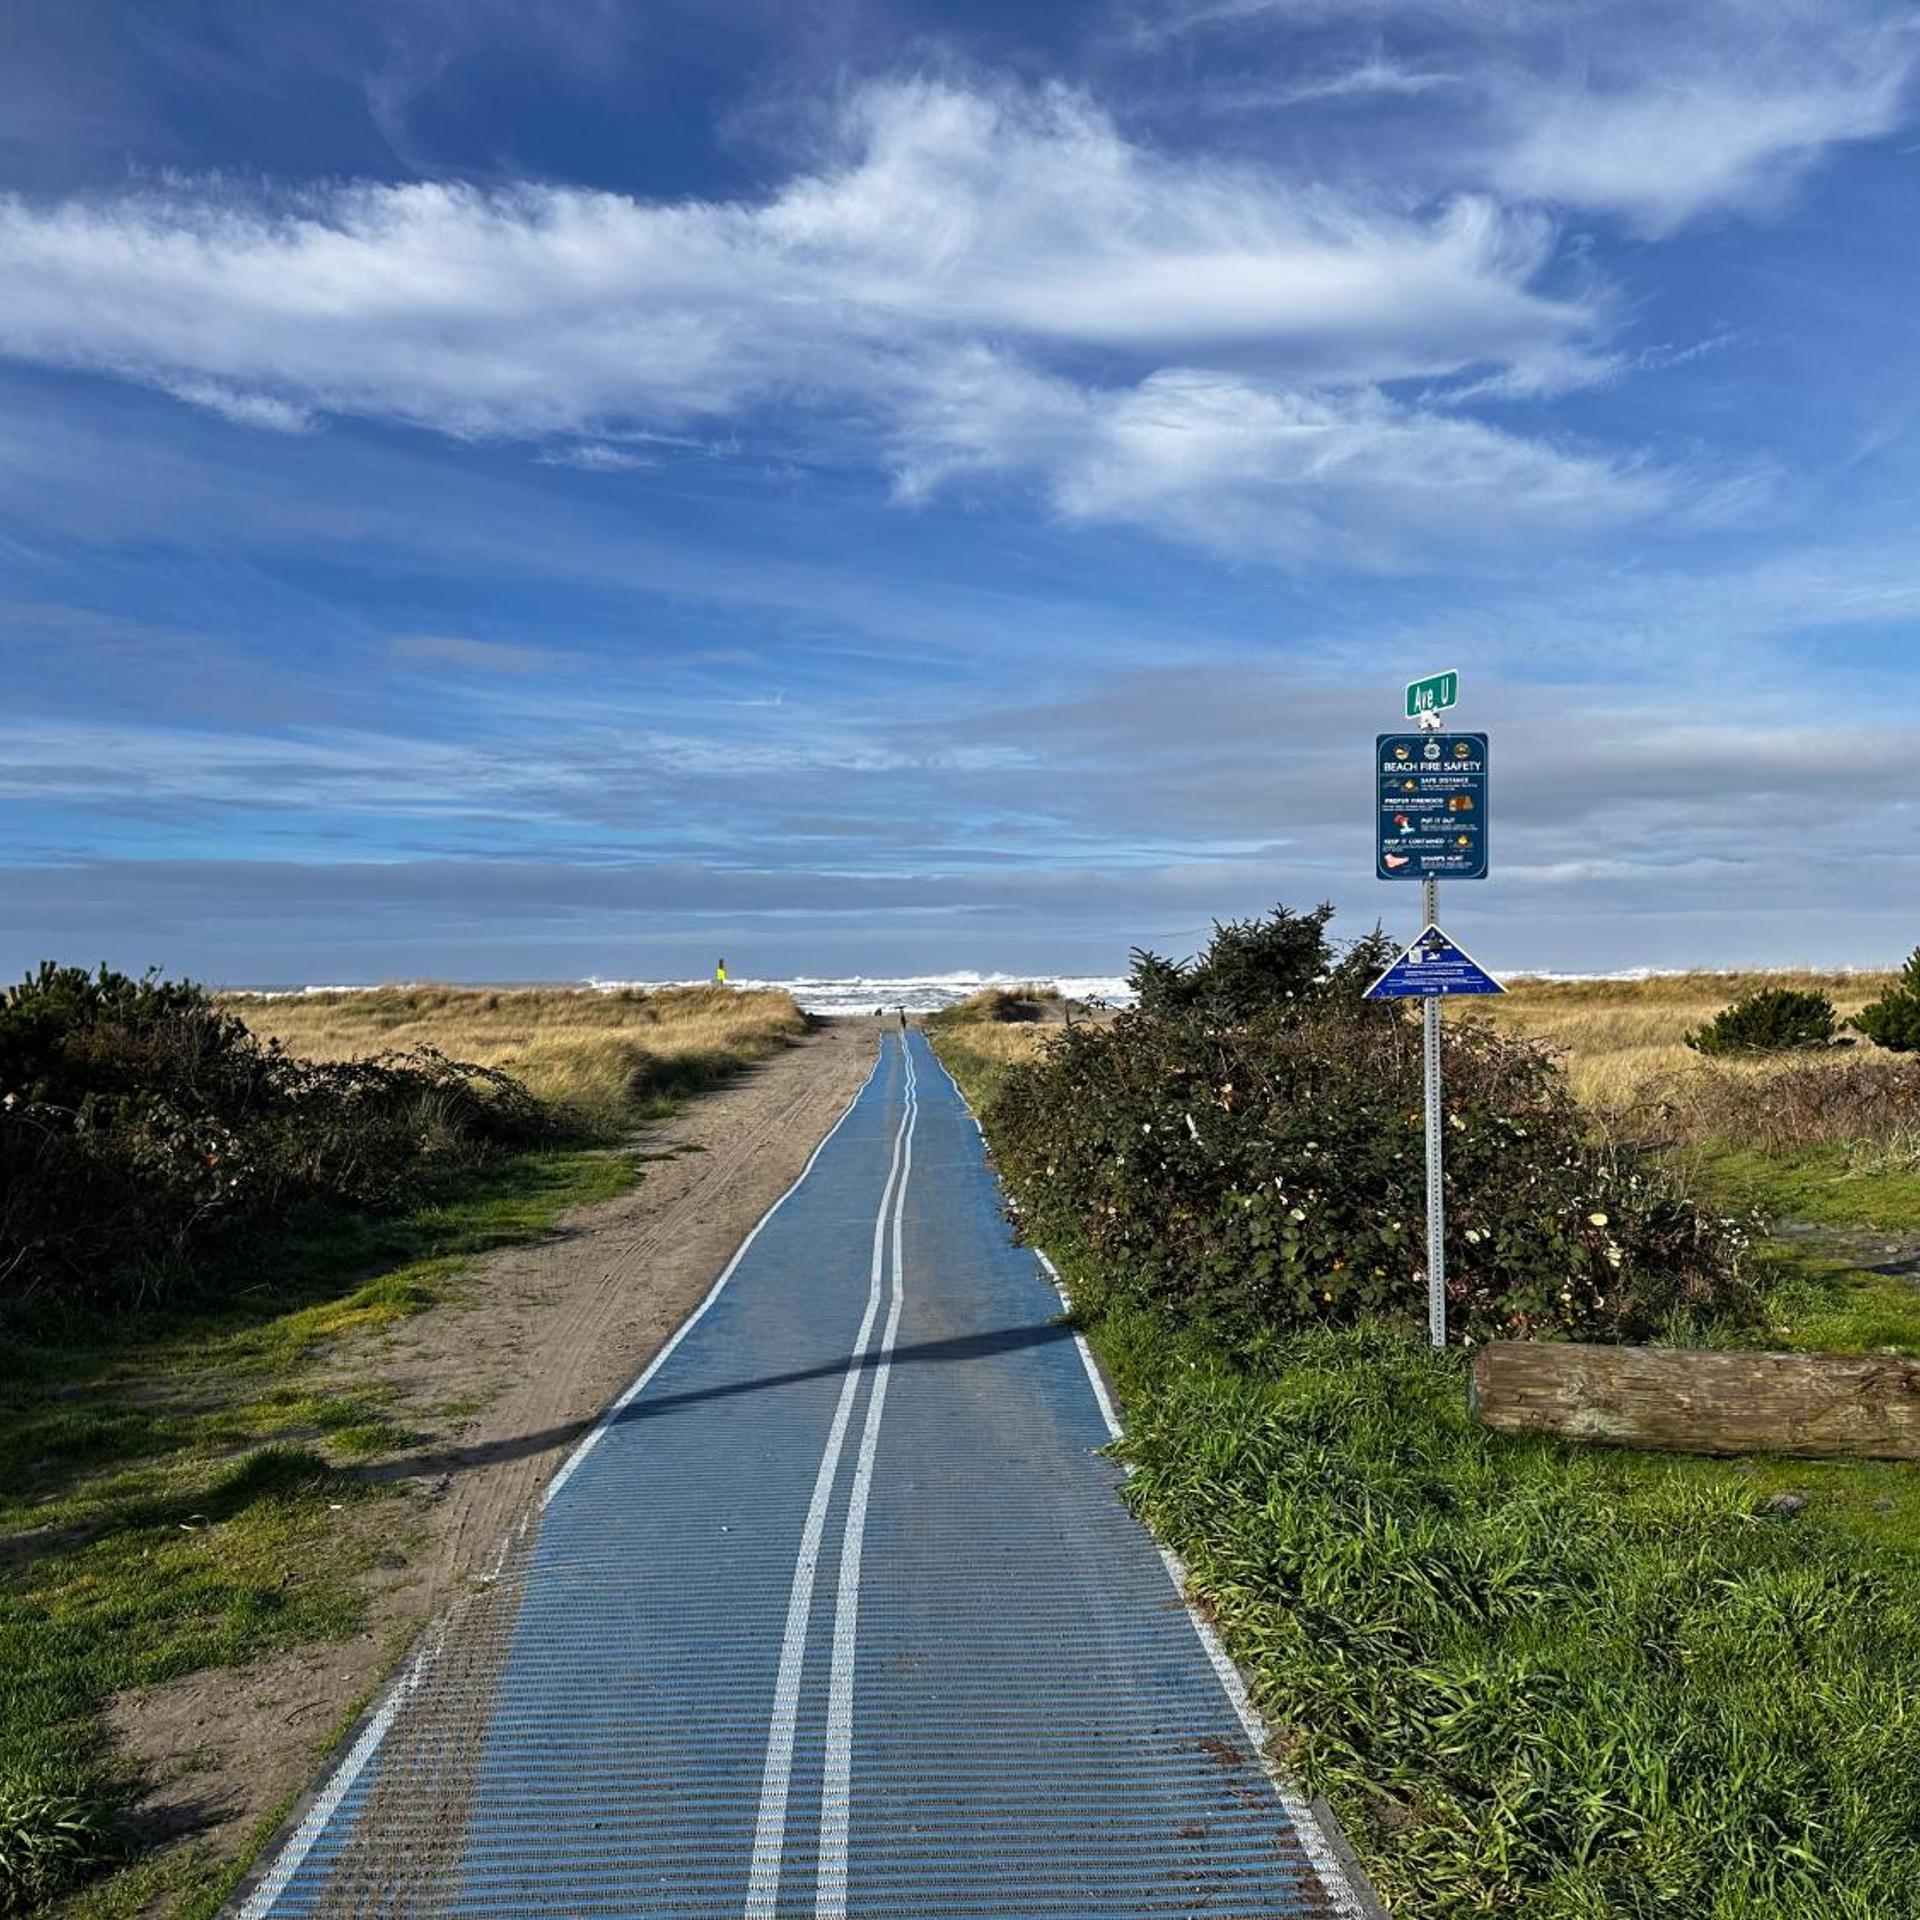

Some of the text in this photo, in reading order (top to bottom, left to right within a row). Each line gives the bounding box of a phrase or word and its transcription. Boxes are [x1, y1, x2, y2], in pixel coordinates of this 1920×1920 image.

[1414, 677, 1449, 712] Ave U
[1384, 762, 1481, 772] BEACH FIRE SAFETY
